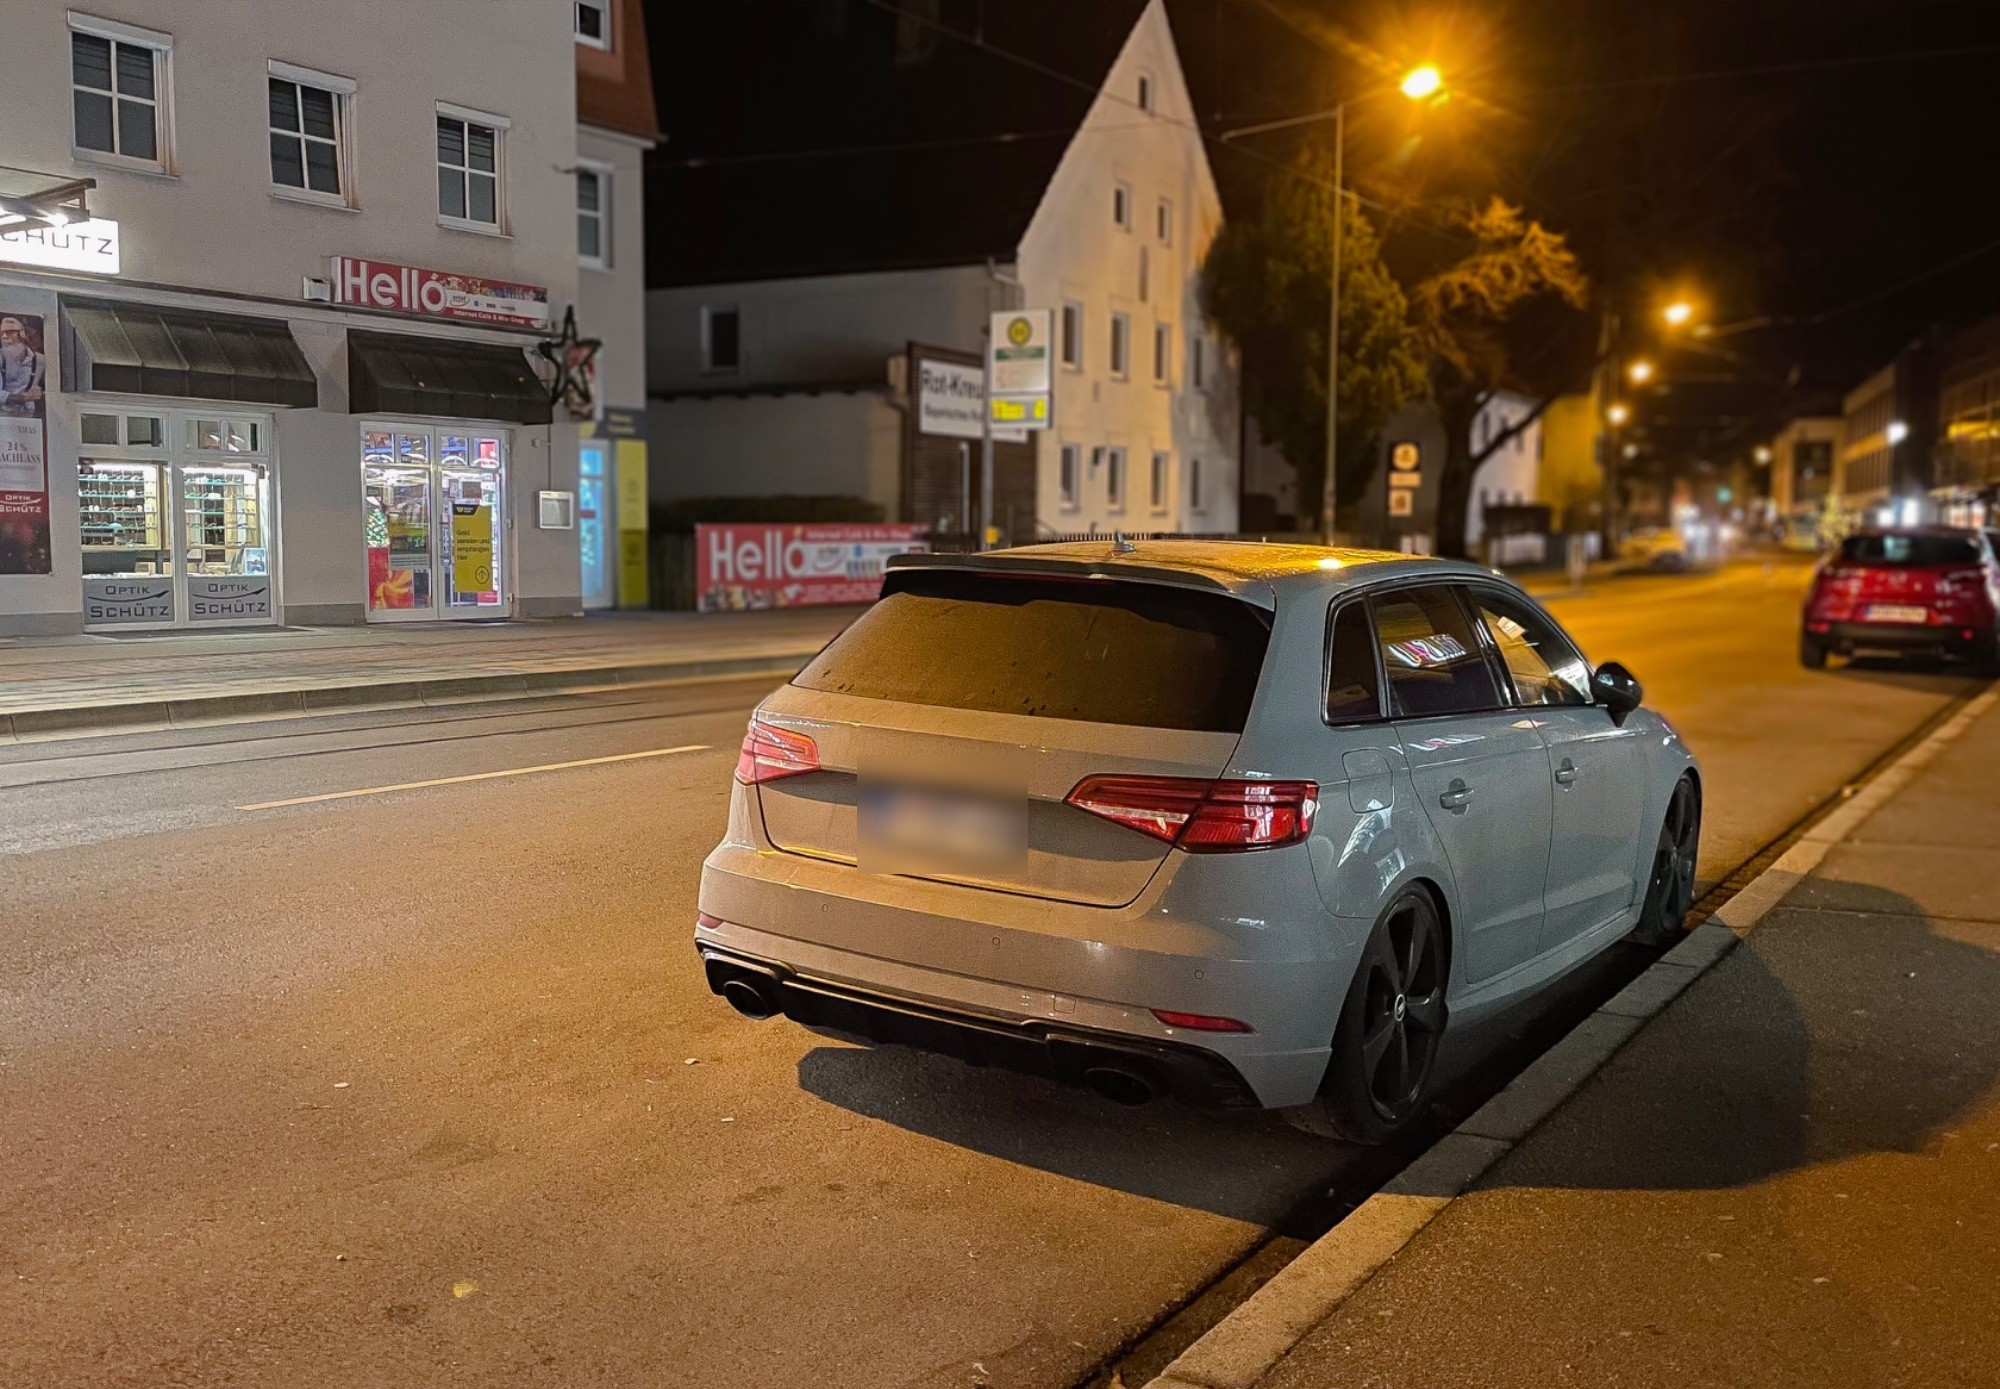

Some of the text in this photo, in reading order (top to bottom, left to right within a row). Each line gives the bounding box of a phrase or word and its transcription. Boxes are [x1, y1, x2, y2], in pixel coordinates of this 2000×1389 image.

[344, 258, 448, 312] Hello
[453, 309, 477, 318] Internet
[0, 453, 41, 463] ACHLASS
[709, 529, 806, 582] Hello
[105, 585, 151, 595] OPTIK
[208, 583, 249, 593] OPTIK
[90, 602, 170, 618] SCHÜTZ
[194, 599, 267, 615] SCHÜTZ
